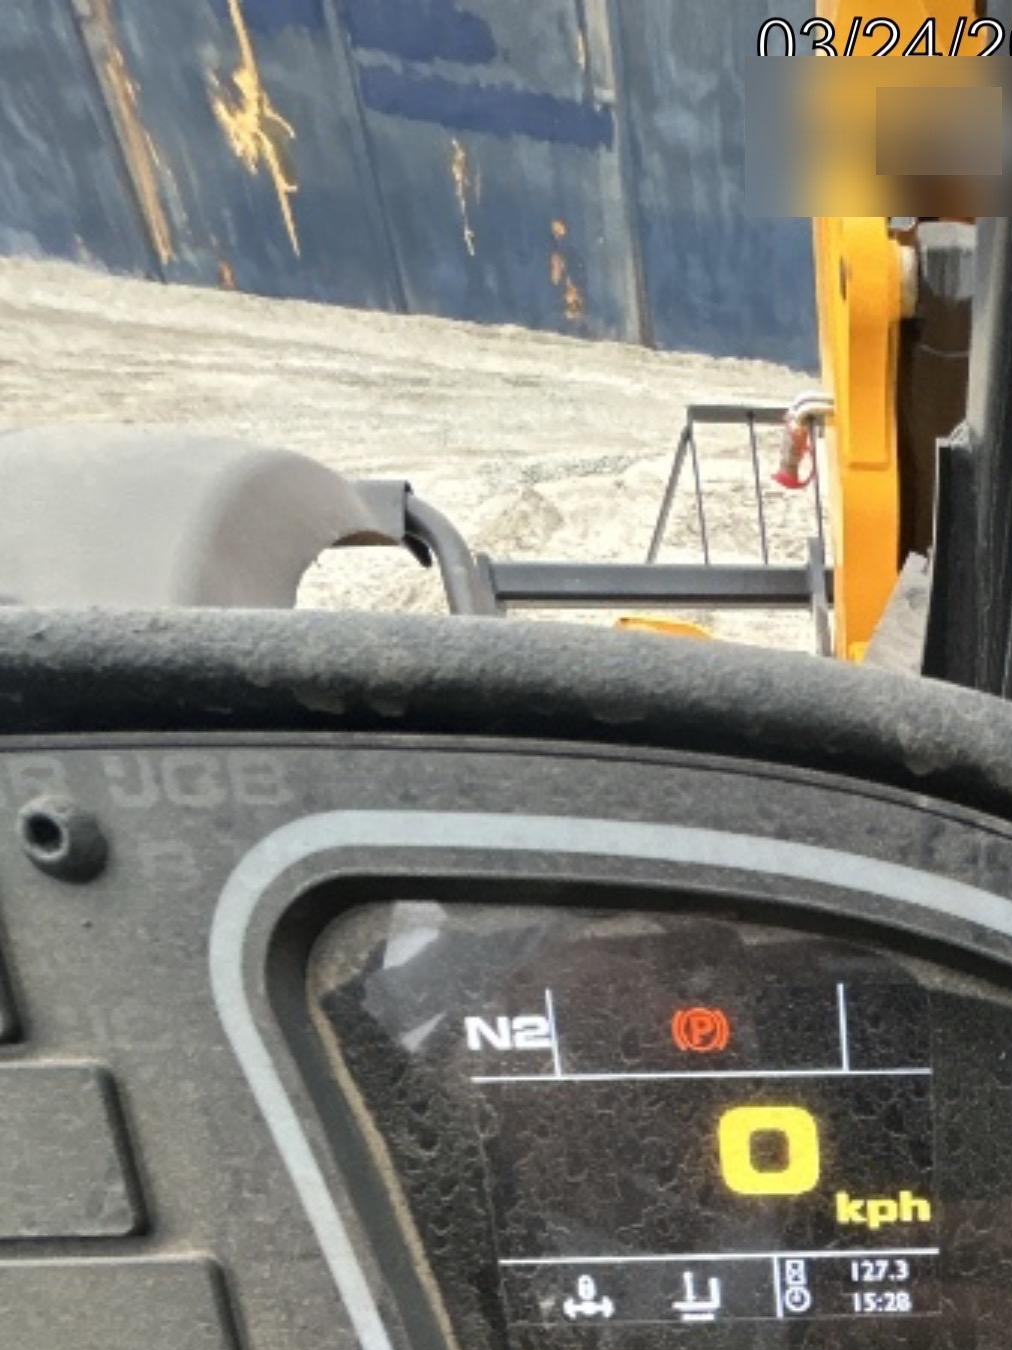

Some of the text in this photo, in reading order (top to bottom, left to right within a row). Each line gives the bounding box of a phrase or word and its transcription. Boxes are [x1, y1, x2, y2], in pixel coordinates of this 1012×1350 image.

[464, 1015, 552, 1051] N2
[718, 1106, 820, 1195] 0
[835, 1192, 932, 1229] kph
[851, 1260, 910, 1281] 127.3
